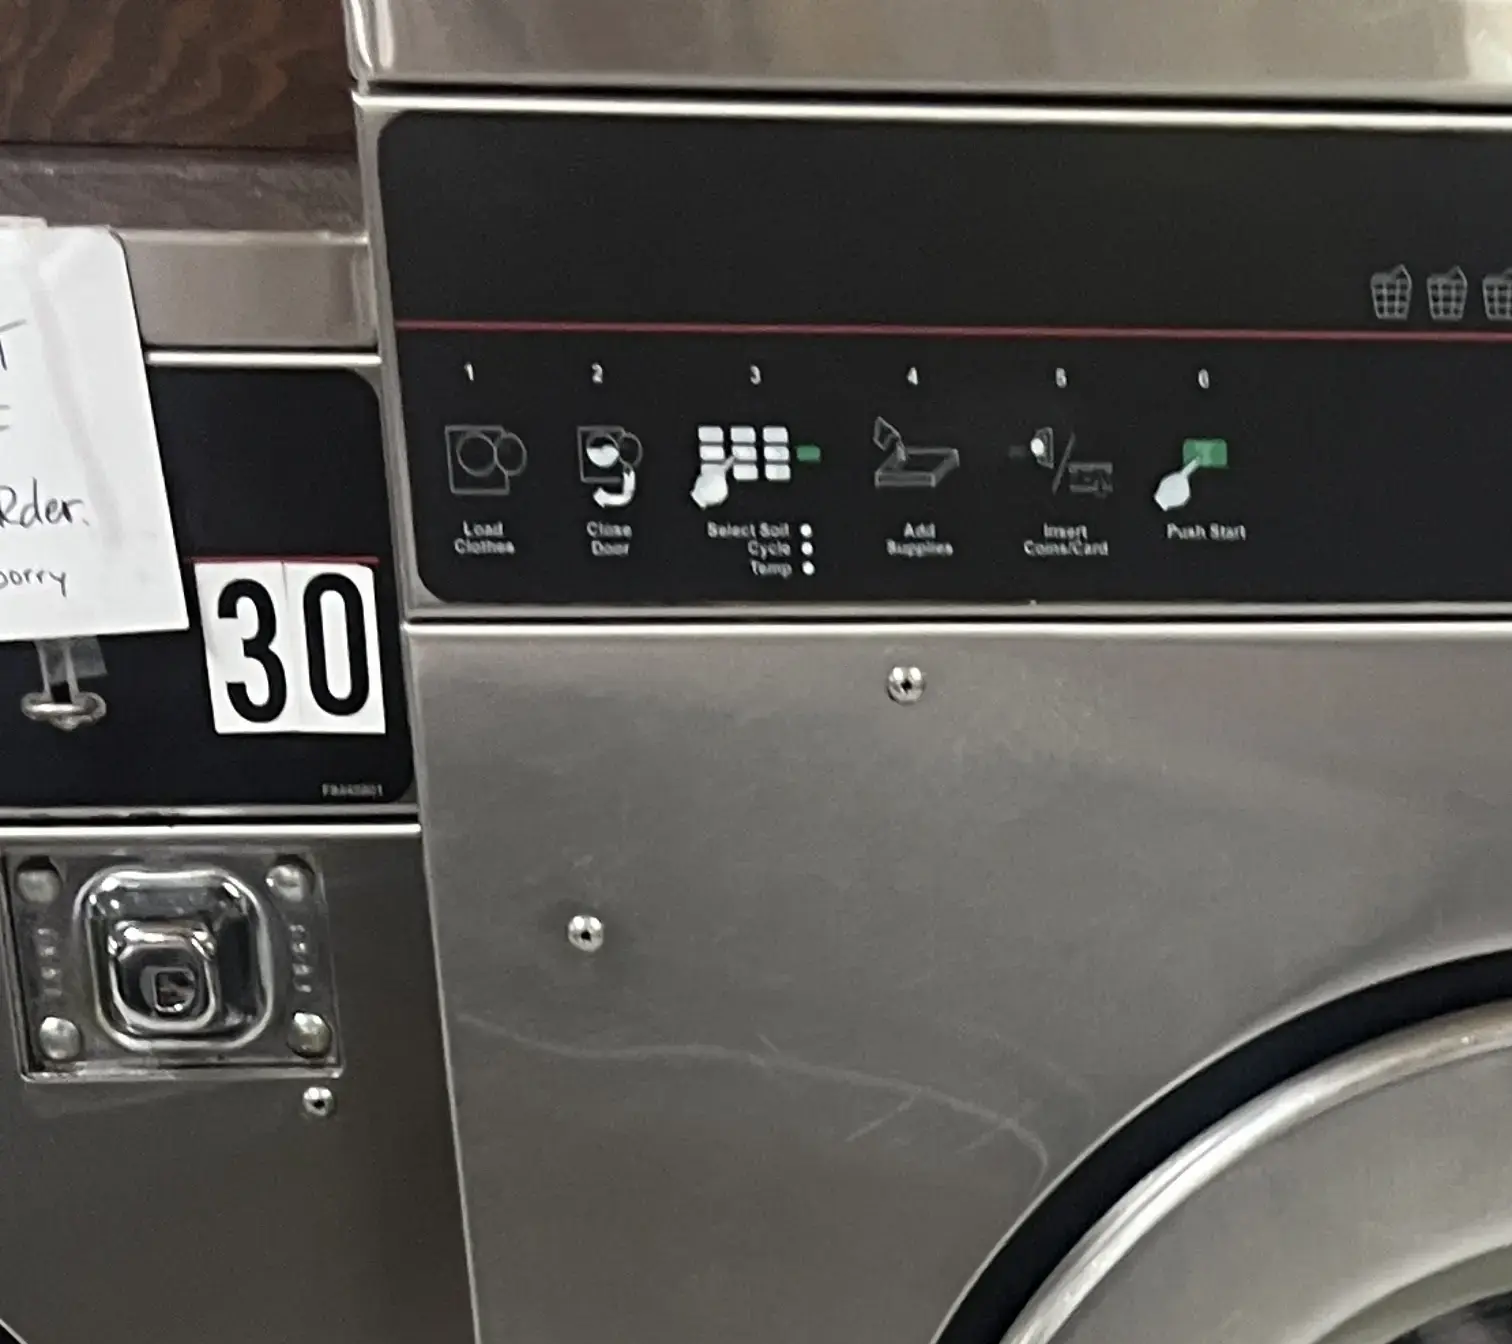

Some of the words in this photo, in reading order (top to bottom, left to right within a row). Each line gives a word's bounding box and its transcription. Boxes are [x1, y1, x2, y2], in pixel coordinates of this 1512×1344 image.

[464, 362, 475, 382] 1
[592, 363, 603, 383] 2
[750, 364, 762, 385] 3
[907, 366, 918, 385] 4
[462, 520, 504, 537] Load
[586, 521, 633, 538] Close
[707, 521, 756, 538] Select
[759, 521, 790, 538] Soil
[903, 522, 936, 539] Add
[1166, 522, 1206, 541] Push
[1210, 522, 1247, 541] Start
[454, 538, 516, 555] Clothes
[591, 539, 629, 557] Door
[747, 540, 792, 560] Cycle
[750, 560, 793, 579] Temp
[216, 573, 370, 724] 30
